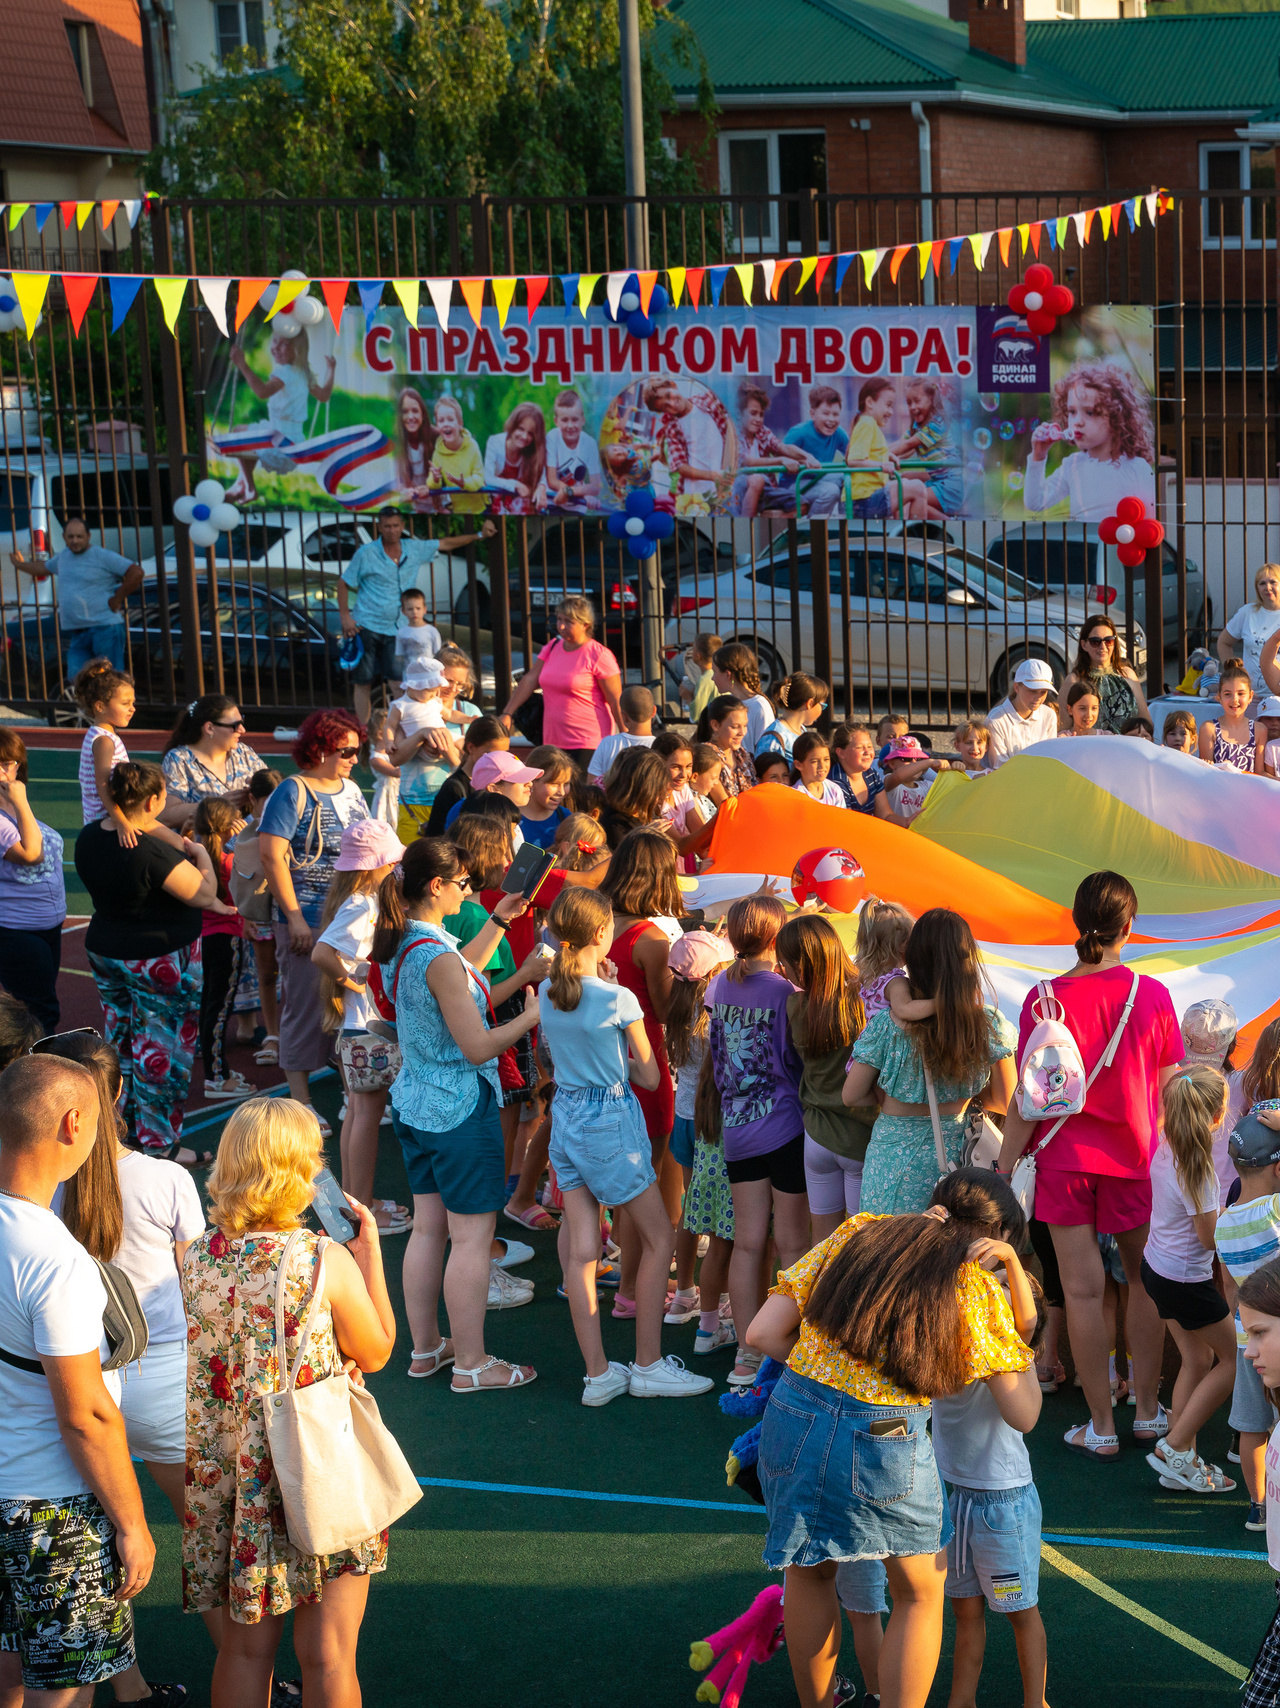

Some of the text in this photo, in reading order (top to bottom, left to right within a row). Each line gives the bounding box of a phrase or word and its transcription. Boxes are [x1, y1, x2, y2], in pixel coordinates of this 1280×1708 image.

[364, 326, 973, 384] С ПРАЗДНИКОМ ДВОРА!
[992, 364, 1037, 374] ЕДИНАЯ
[992, 374, 1037, 383] РОССИЯ
[1265, 1443, 1279, 1470] rn
[33, 1509, 56, 1522] OCEAN
[1006, 1592, 1023, 1601] STOP
